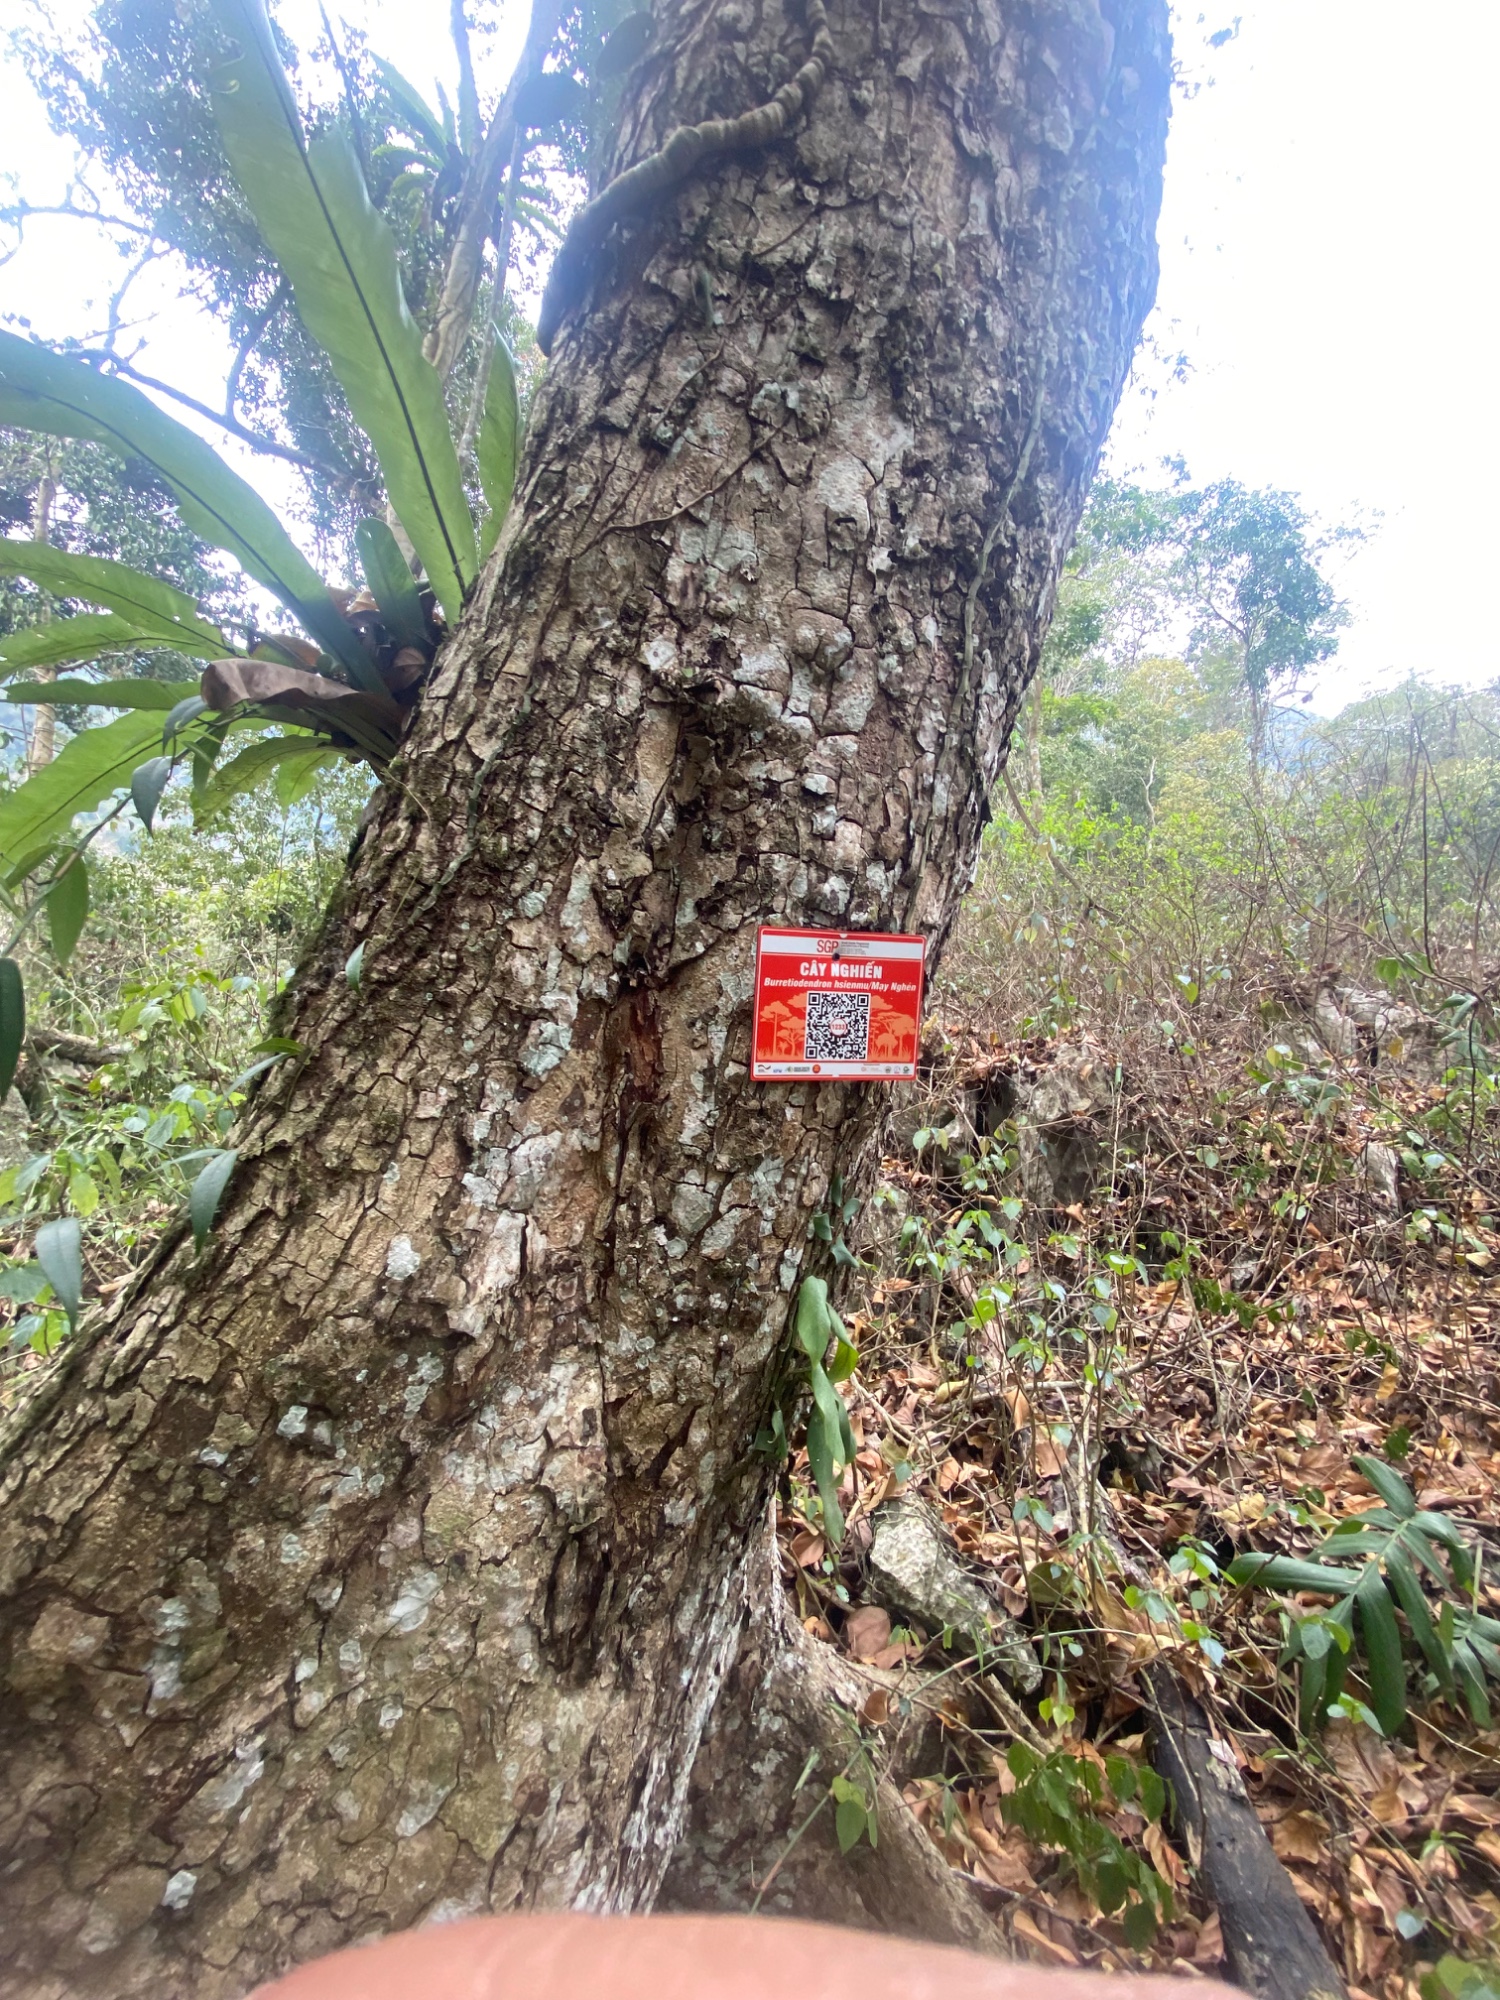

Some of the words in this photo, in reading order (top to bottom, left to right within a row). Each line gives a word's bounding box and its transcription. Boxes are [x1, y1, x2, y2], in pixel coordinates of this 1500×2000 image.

[816, 939, 839, 953] SGP
[800, 960, 827, 976] CÂY
[831, 961, 882, 979] NGHIẾN
[764, 977, 832, 988] Burretiodendron
